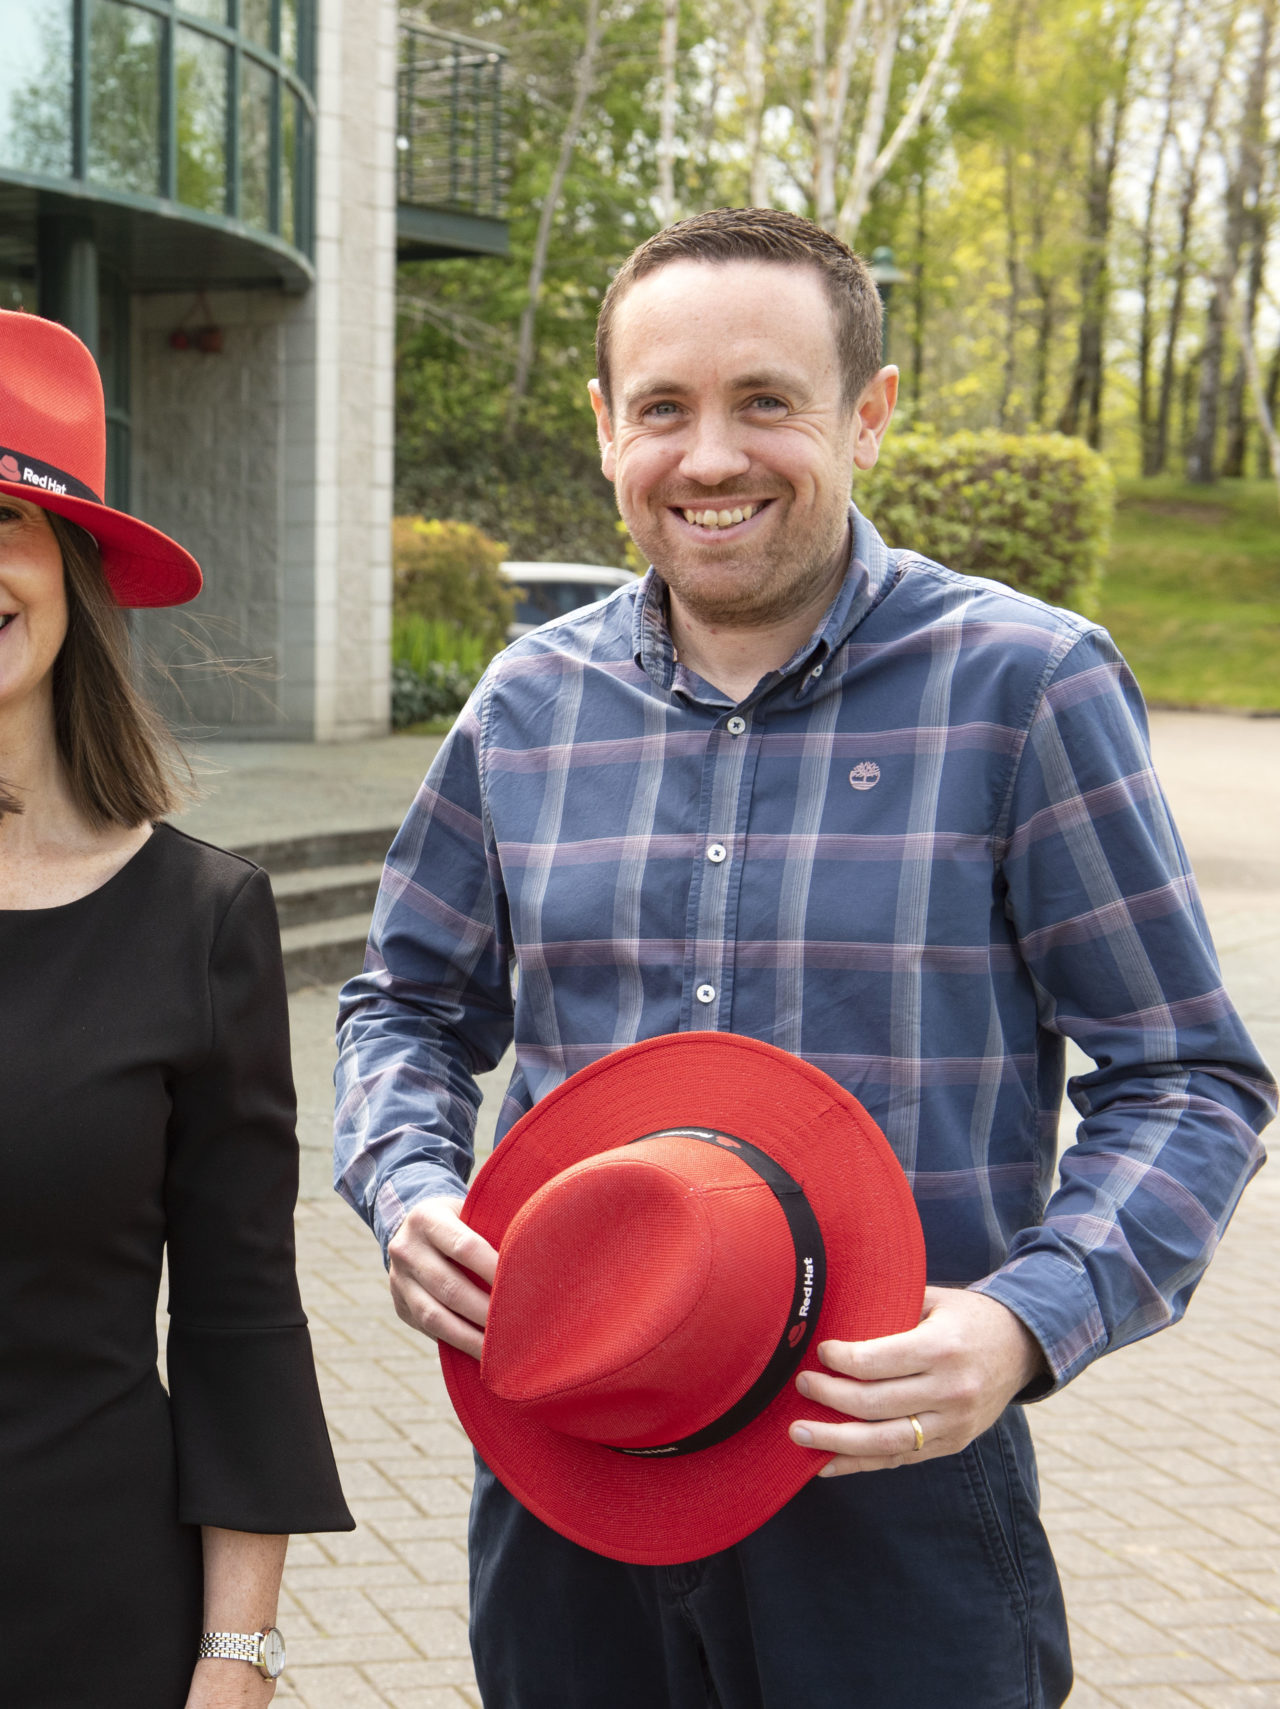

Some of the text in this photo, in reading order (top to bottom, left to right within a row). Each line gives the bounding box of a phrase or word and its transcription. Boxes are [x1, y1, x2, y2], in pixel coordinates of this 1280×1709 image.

[23, 467, 67, 495] Red Hat
[798, 1257, 814, 1317] Red Hat
